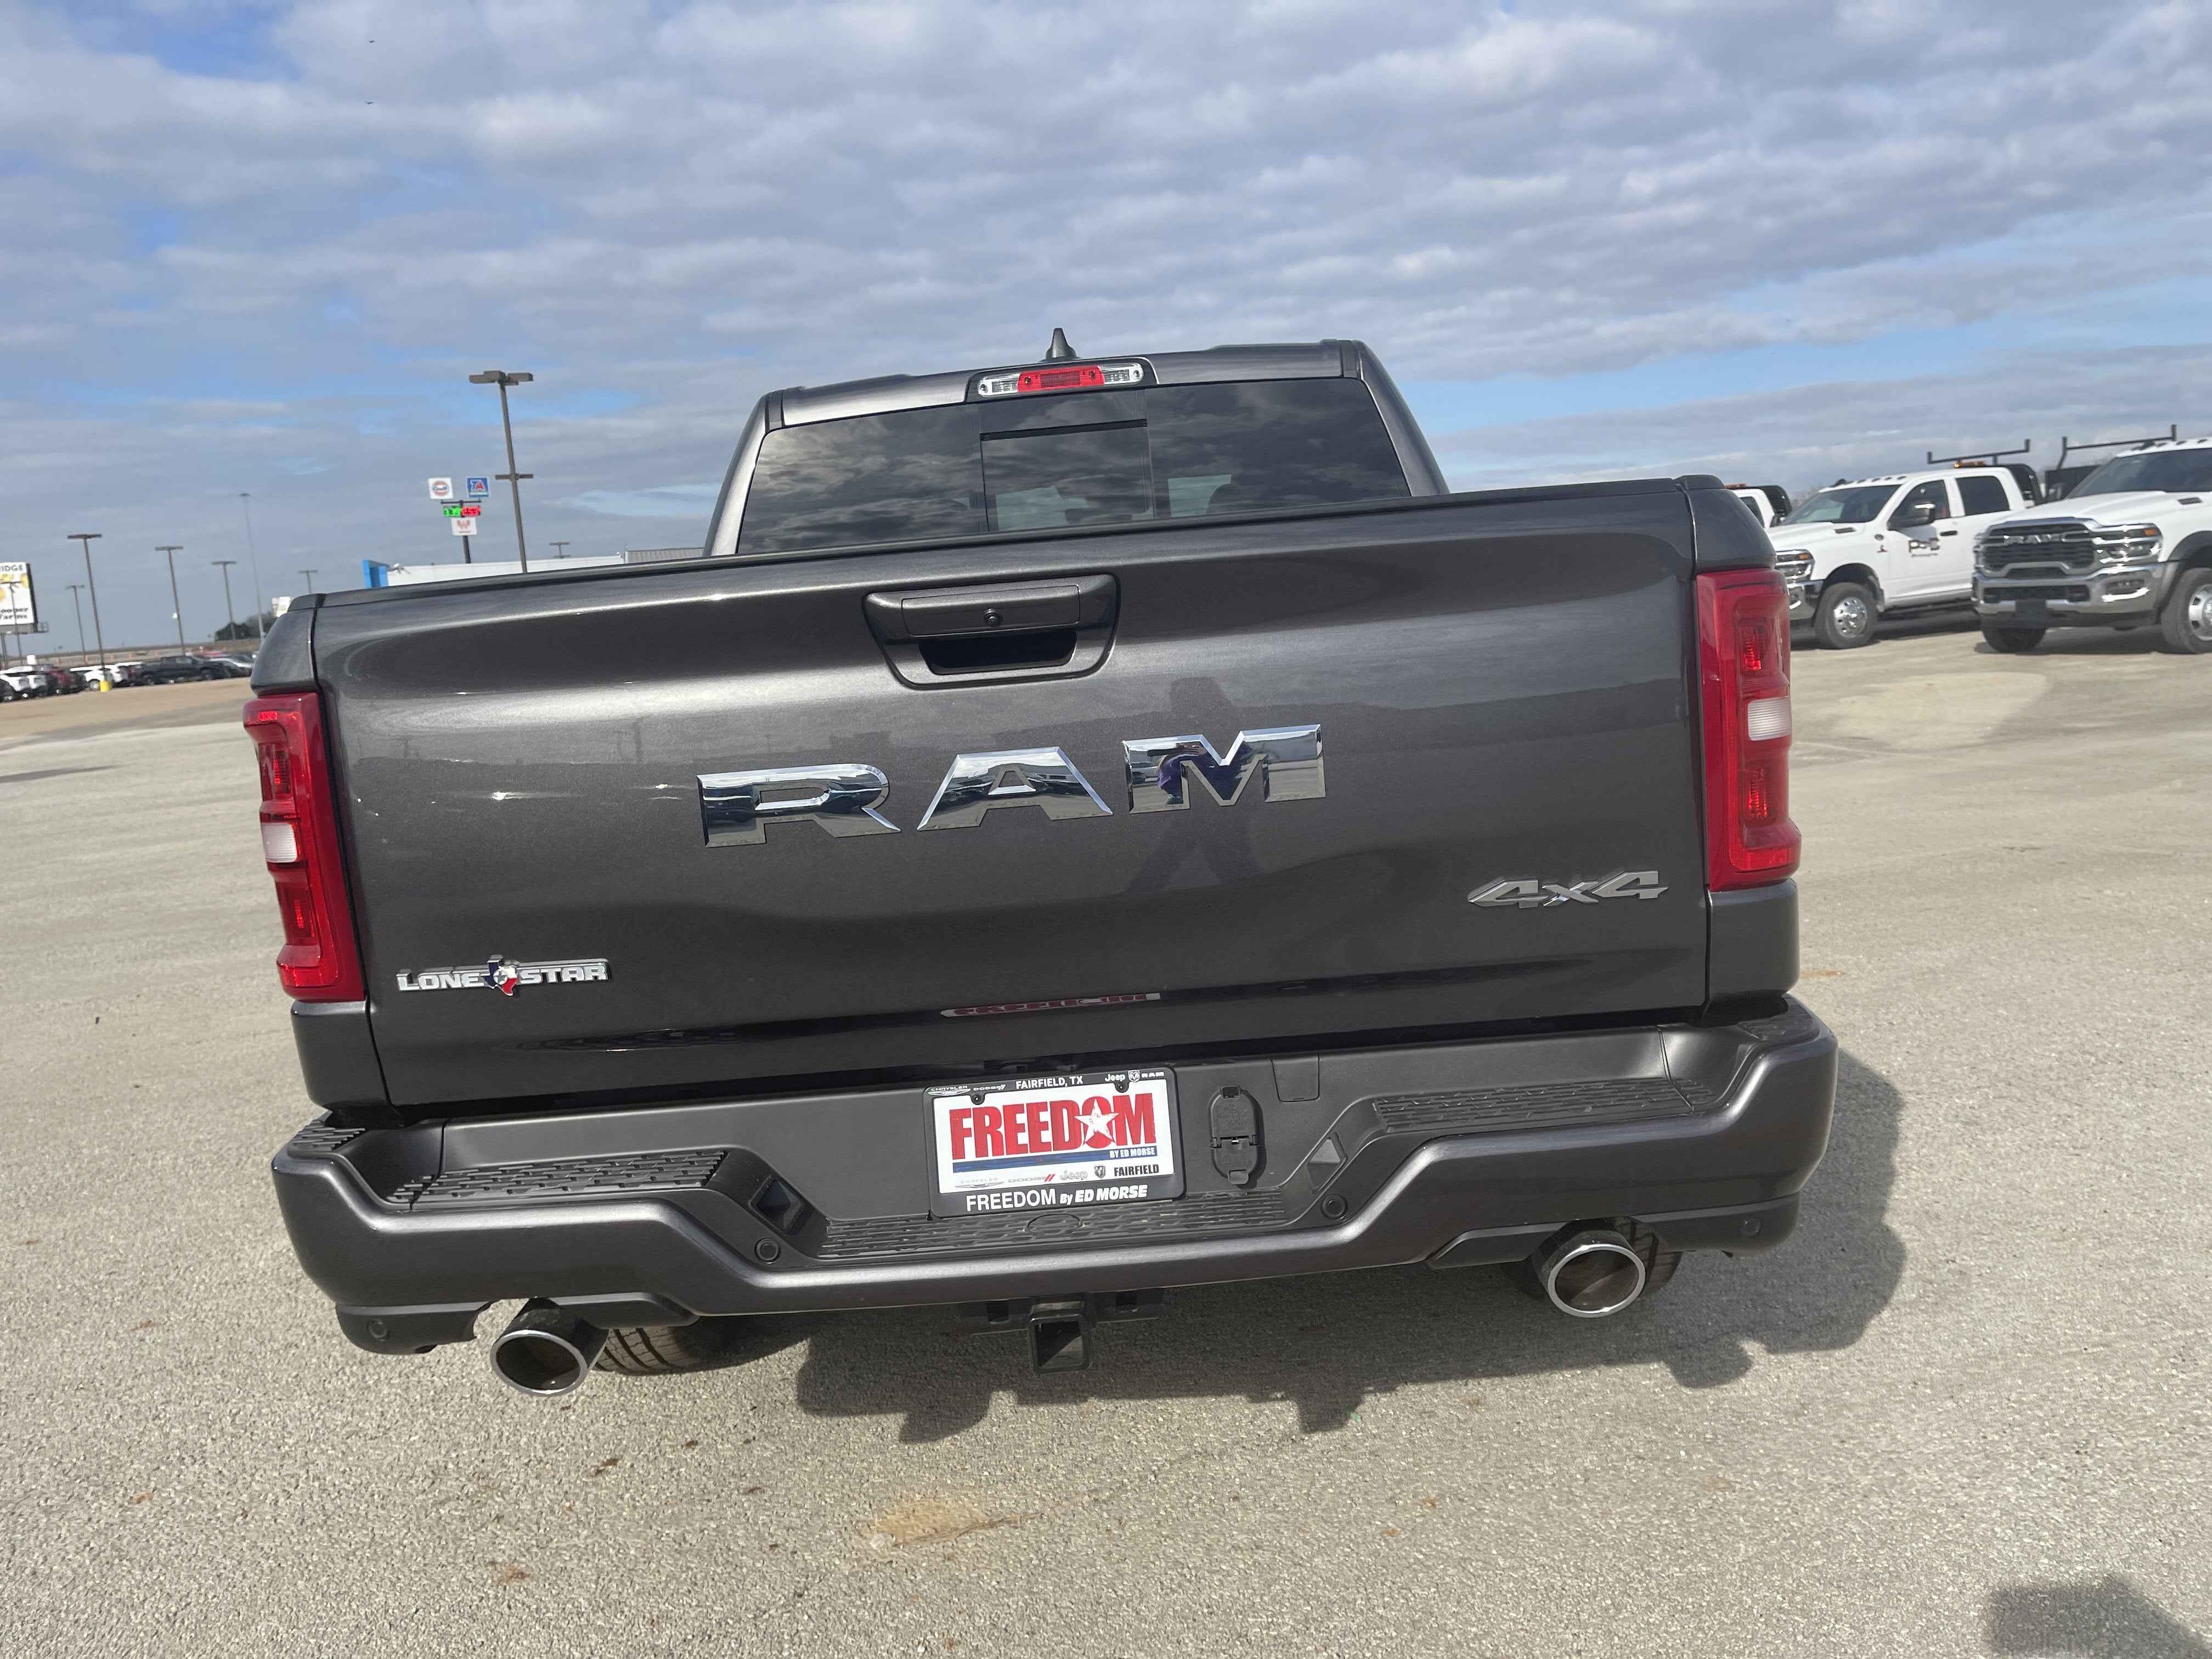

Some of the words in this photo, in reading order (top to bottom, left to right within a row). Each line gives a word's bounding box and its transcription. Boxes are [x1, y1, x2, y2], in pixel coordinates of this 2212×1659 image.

[697, 724, 1326, 848] RAM
[396, 971, 484, 992] LONE
[520, 963, 610, 985] STAR
[1015, 1077, 1068, 1090] FAIRFIELD,
[1069, 1075, 1084, 1085] TX
[1104, 1073, 1126, 1082] Jeep
[949, 1093, 1156, 1160] FREEDOM
[1109, 1149, 1120, 1159] BY
[1121, 1148, 1130, 1158] ED
[1130, 1147, 1155, 1157] MORSE
[1059, 1170, 1088, 1181] Jeep
[1114, 1164, 1159, 1177] FAIRFIELD
[966, 1188, 1056, 1212] FREEDOM
[1059, 1193, 1073, 1205] By
[1075, 1188, 1094, 1203] ED
[1096, 1184, 1148, 1201] MORSE
